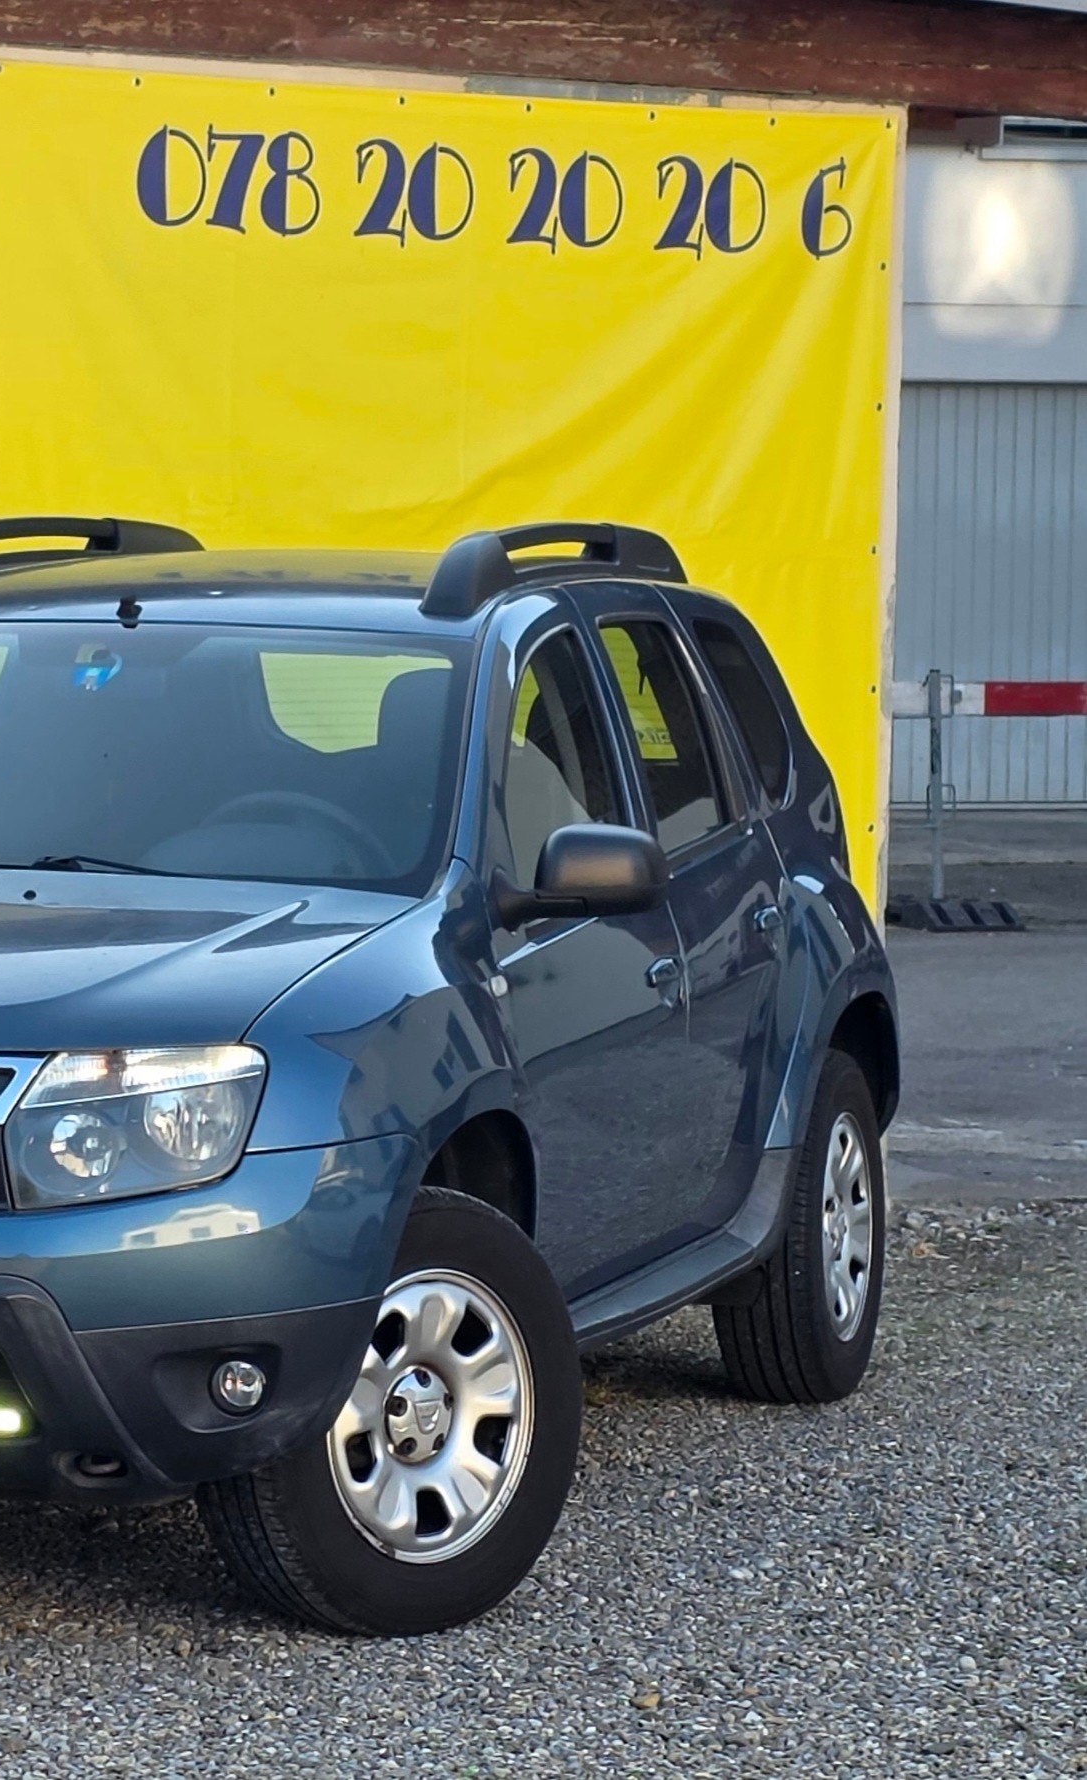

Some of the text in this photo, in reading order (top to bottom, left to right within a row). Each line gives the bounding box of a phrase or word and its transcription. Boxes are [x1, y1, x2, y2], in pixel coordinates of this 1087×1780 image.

[137, 124, 852, 261] 078 20 20 20 6
